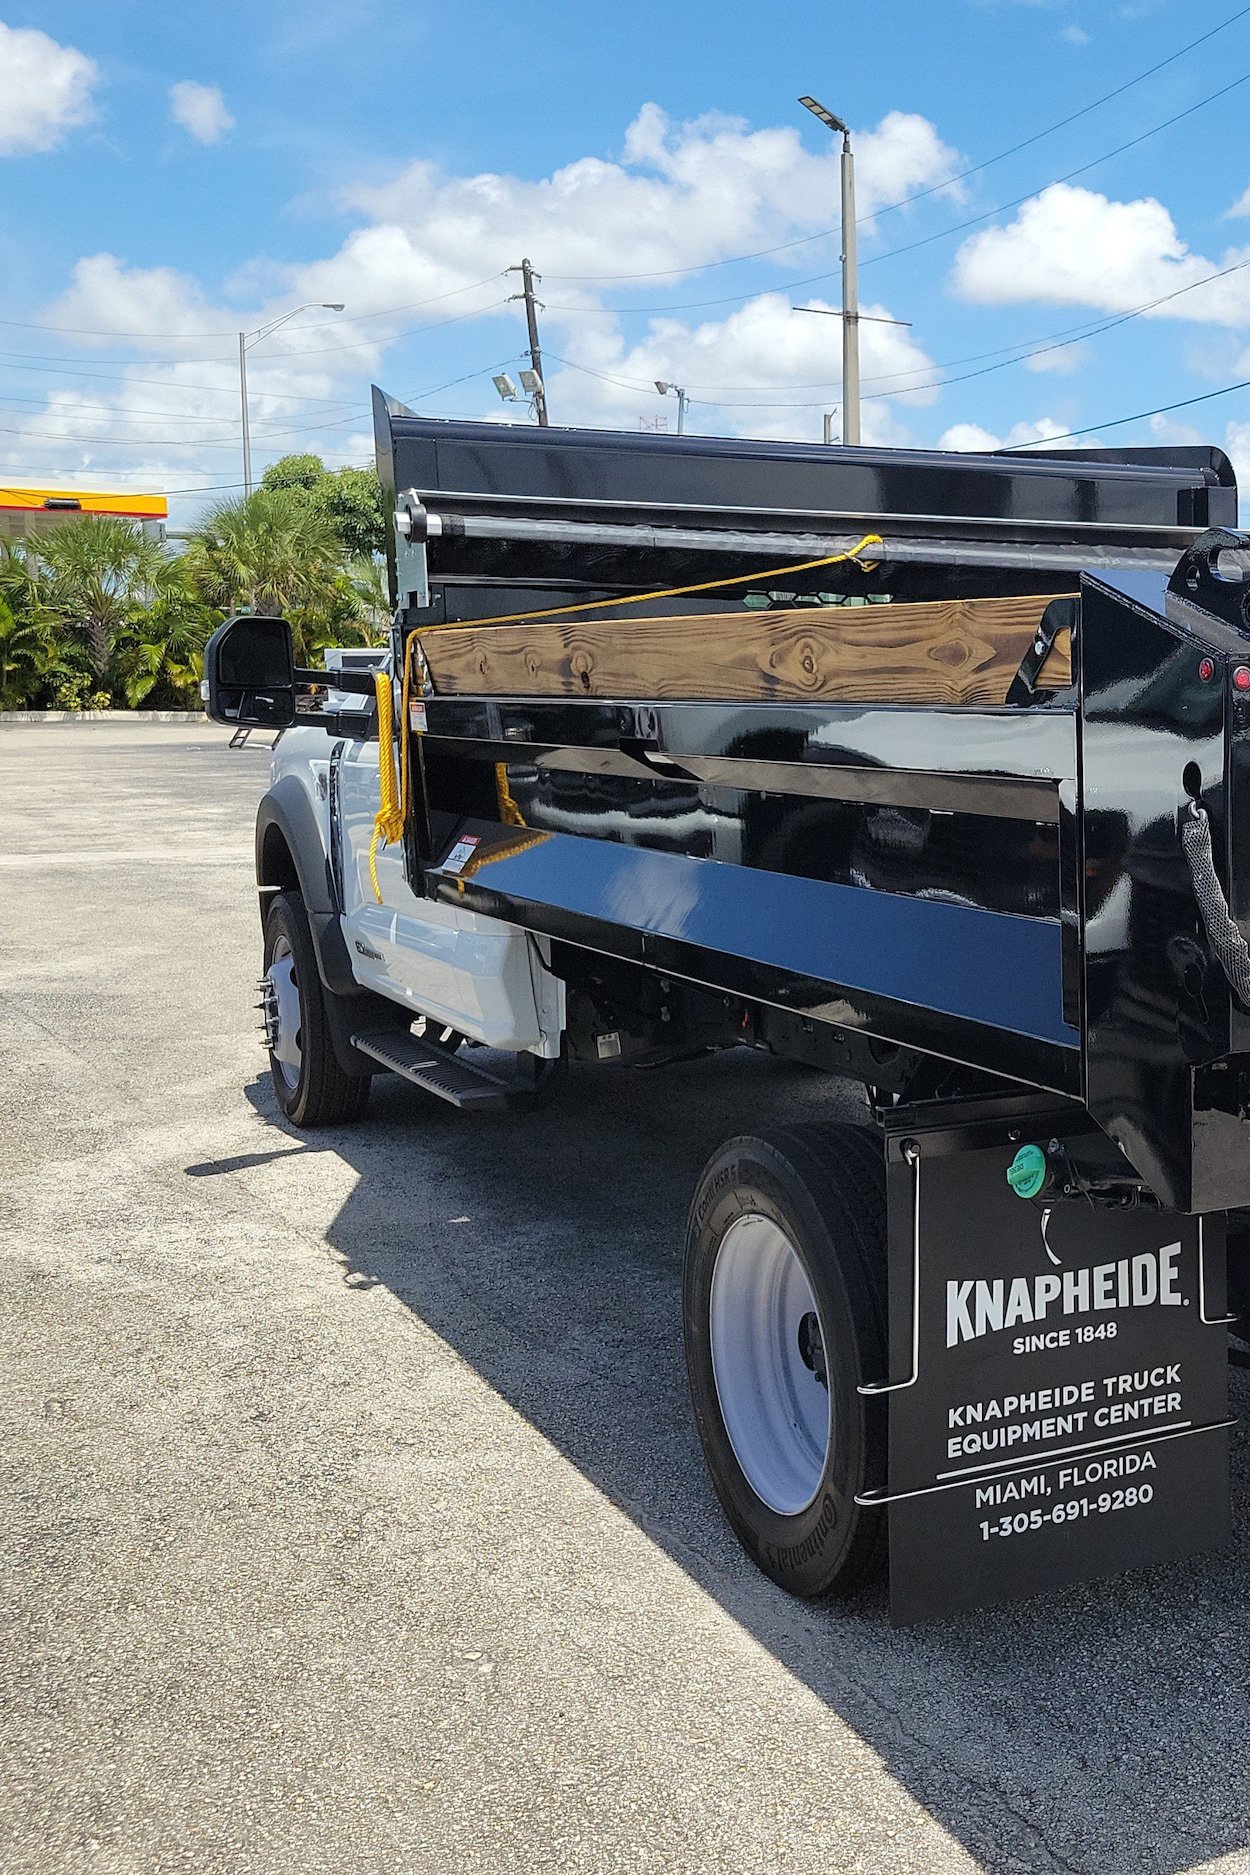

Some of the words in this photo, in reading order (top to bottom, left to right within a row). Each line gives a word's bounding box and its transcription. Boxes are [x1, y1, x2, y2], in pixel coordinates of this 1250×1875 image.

[1012, 1329, 1071, 1355] SINCE
[1075, 1321, 1118, 1344] 1848
[947, 1411, 1088, 1459] EQUIPMENT
[1094, 1392, 1182, 1428] CENTER
[948, 1381, 1095, 1429] KNAPHEIDE
[1103, 1363, 1182, 1398] TRUCK
[975, 1474, 1052, 1509] MIAMI,
[1059, 1450, 1157, 1490] FLORIDA
[979, 1483, 1154, 1542] 1-305-691-9280
